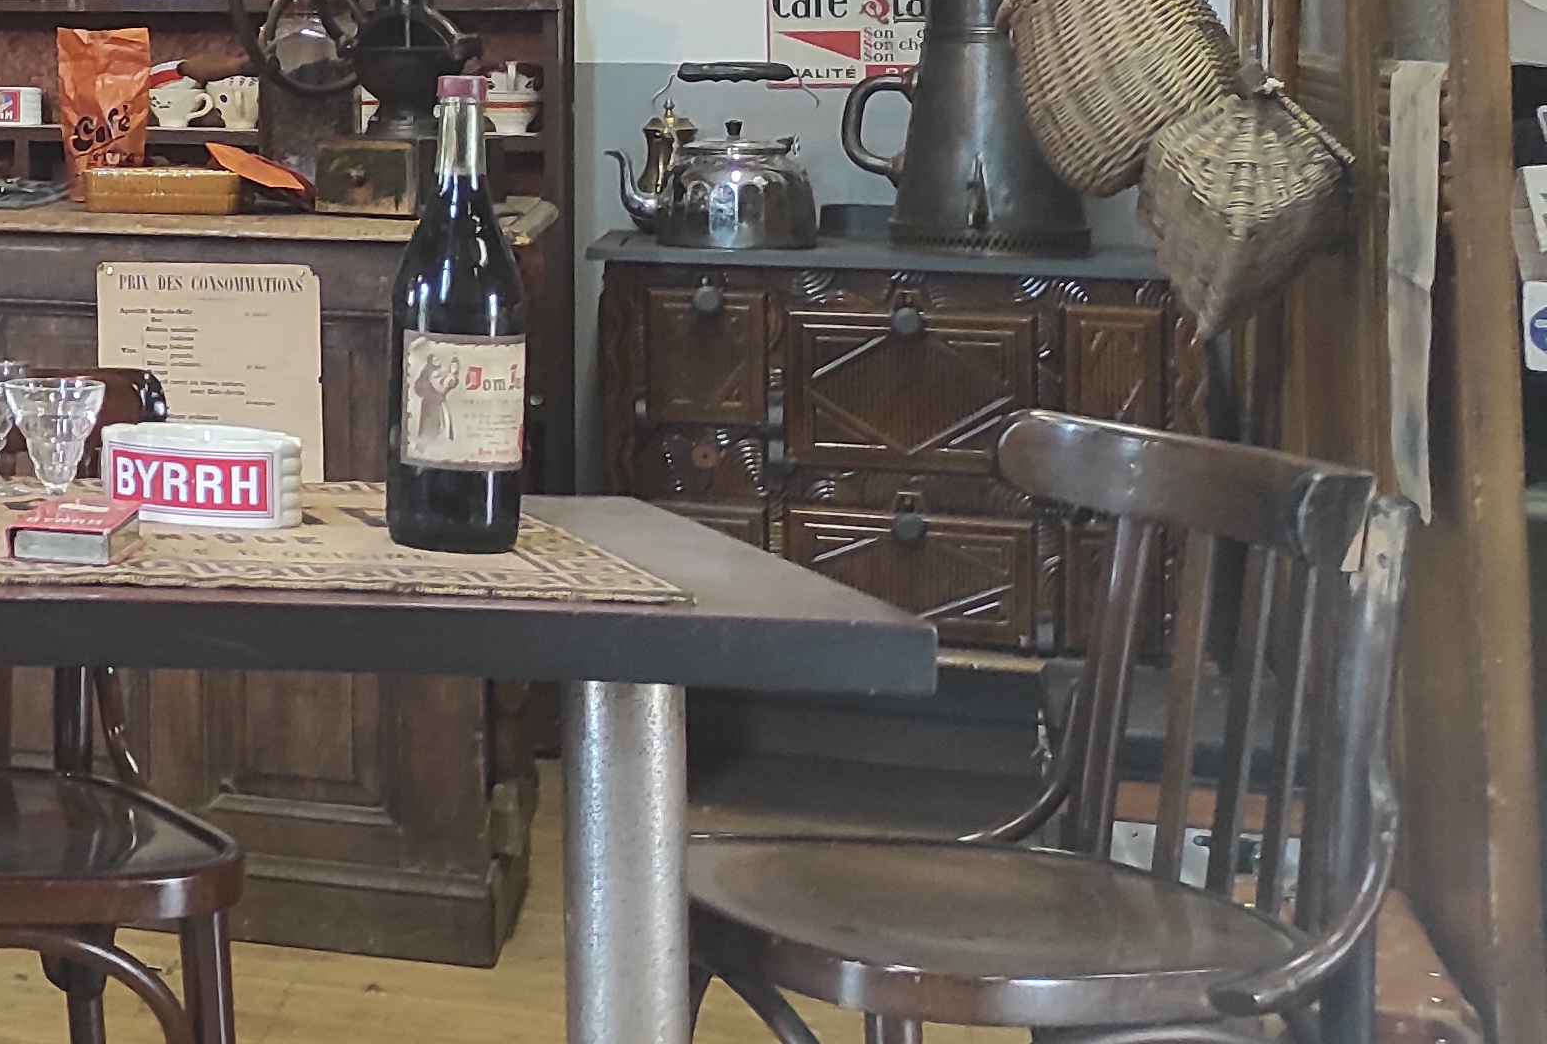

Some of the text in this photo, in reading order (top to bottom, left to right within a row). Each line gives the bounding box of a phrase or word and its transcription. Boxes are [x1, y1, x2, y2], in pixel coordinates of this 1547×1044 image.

[863, 27, 894, 39] Son
[863, 39, 894, 51] Son
[863, 51, 894, 62] Son
[119, 274, 305, 294] PRIX DES CONSOMMATIONS
[116, 455, 260, 506] BYRRH
